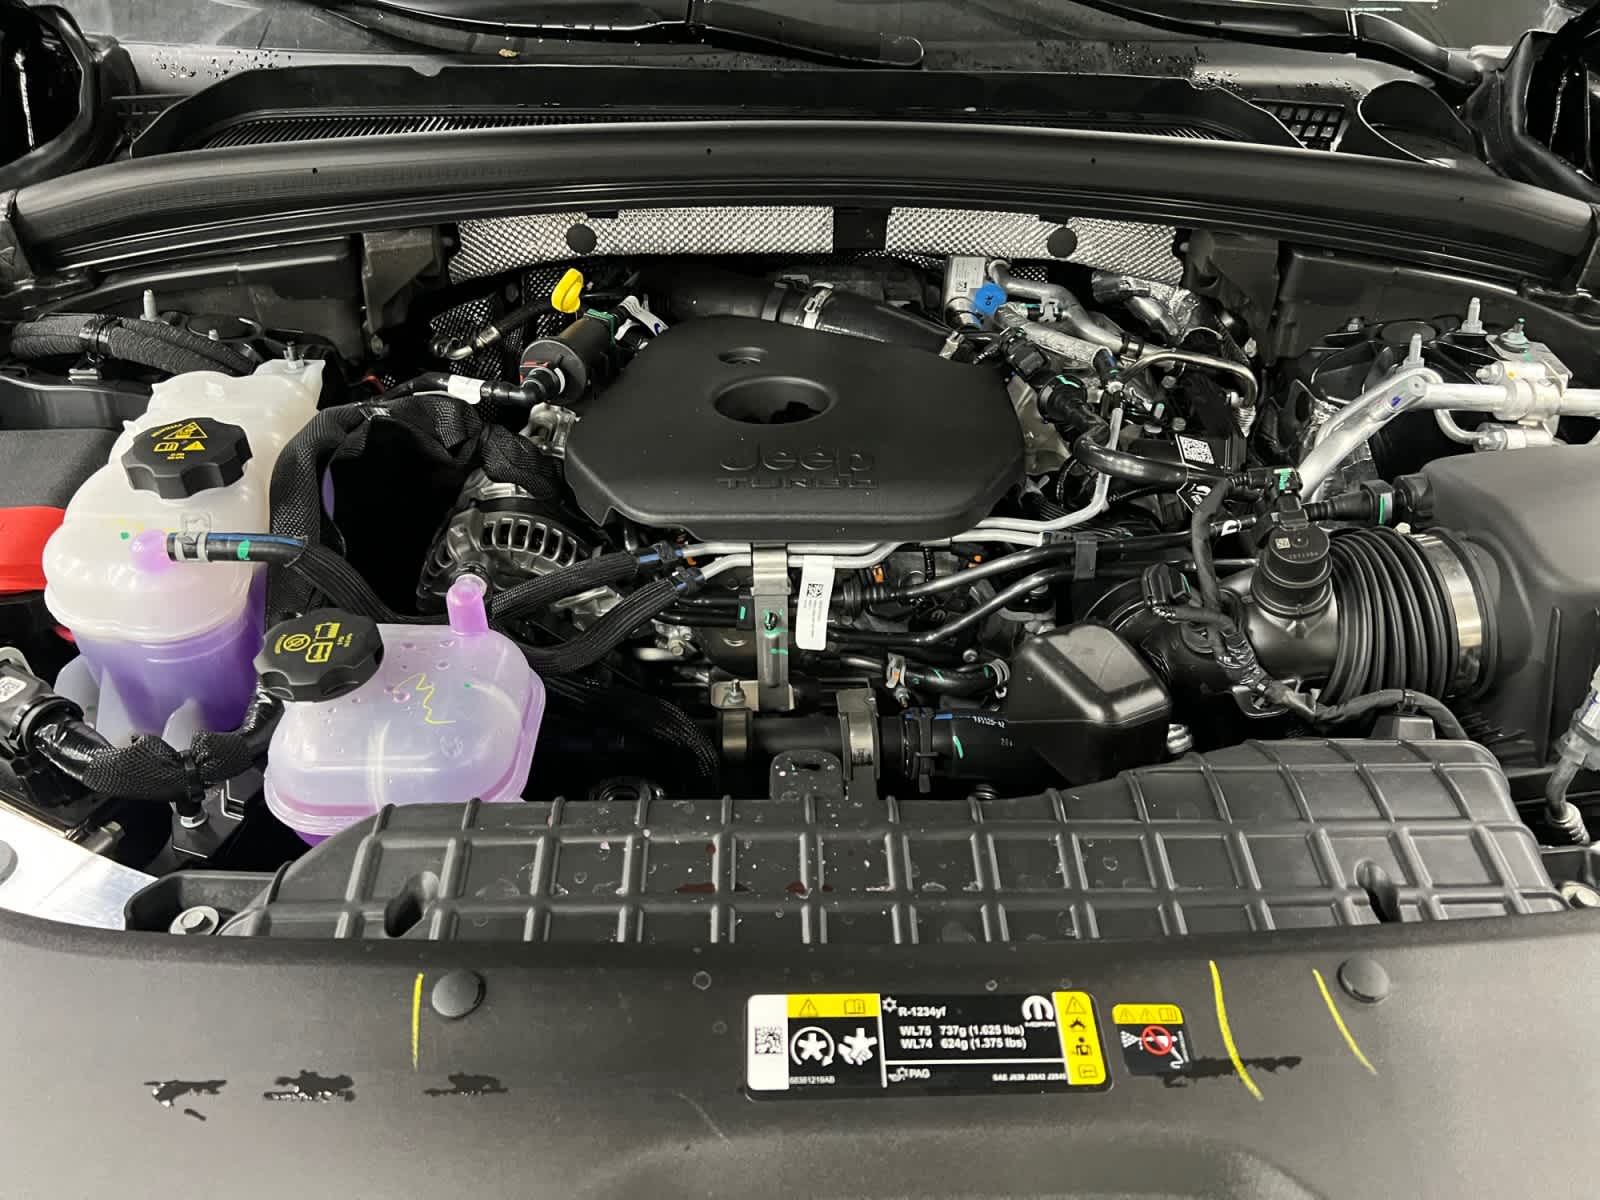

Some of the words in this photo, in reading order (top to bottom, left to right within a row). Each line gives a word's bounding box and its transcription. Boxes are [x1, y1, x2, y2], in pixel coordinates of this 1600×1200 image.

[719, 443, 875, 477] Jeep
[899, 1025, 932, 1037] WL75
[939, 1025, 967, 1038] 737g
[1003, 1024, 1025, 1037] lbs)
[901, 1038, 933, 1049] WL74
[1005, 1037, 1027, 1050] lbs)
